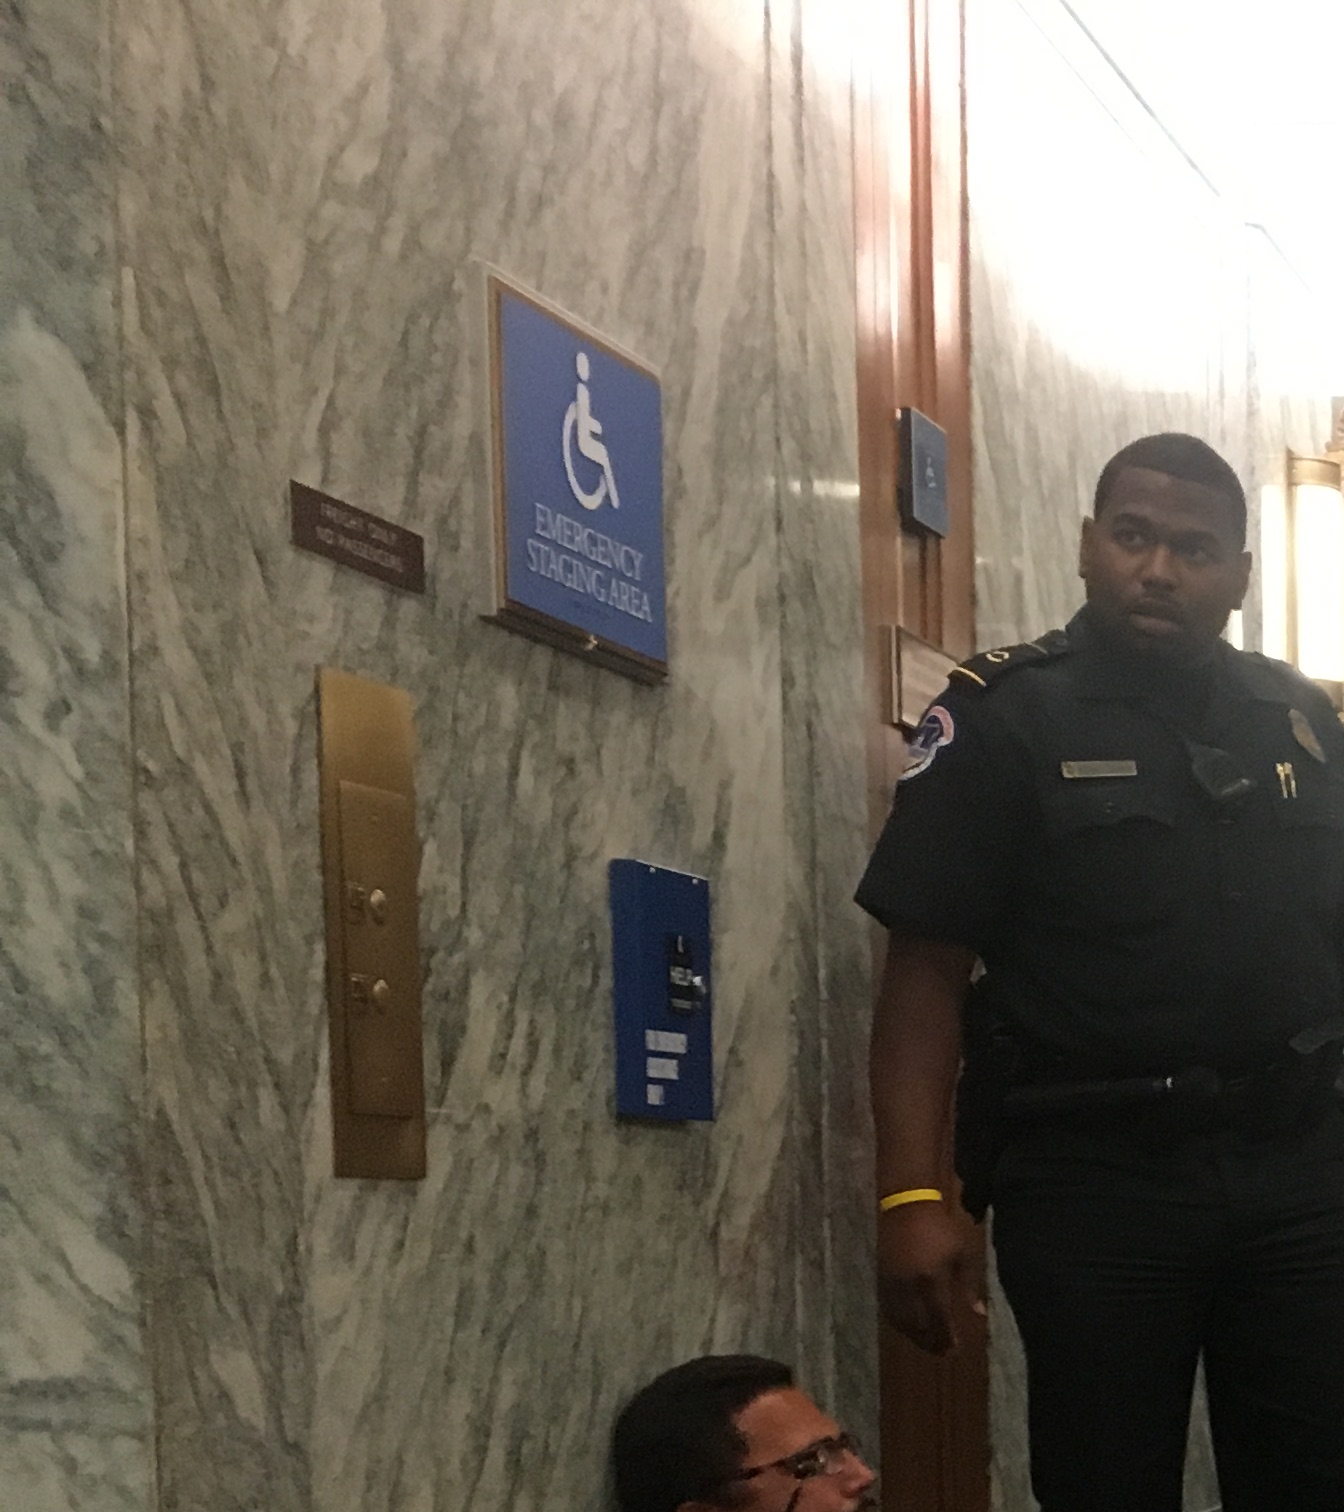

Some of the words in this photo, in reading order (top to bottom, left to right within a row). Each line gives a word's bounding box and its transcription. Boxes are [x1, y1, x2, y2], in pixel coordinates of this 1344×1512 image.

[526, 538, 607, 602] STAGING
[608, 577, 652, 622] AREA
[534, 502, 642, 581] EMERGENCY
